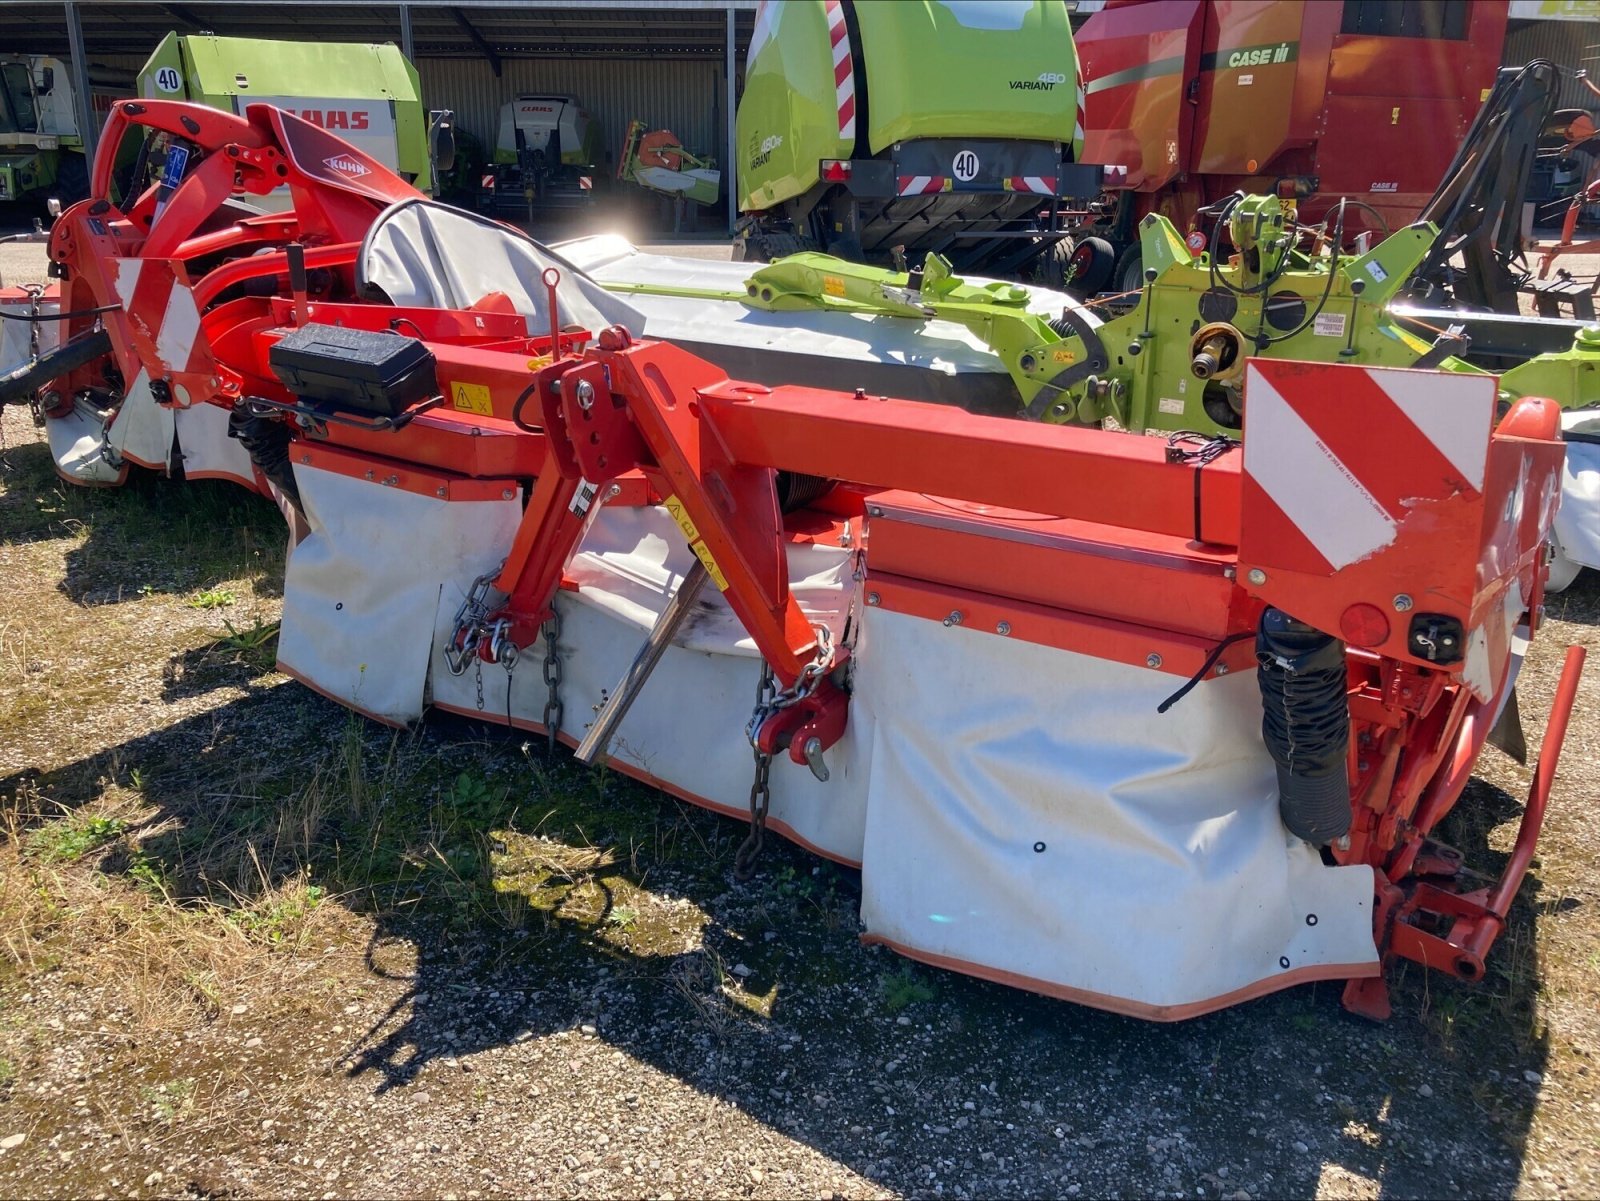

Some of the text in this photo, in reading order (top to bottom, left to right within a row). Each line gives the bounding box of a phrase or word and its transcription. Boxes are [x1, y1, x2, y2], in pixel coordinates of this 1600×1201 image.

[1228, 49, 1272, 68] CASE
[159, 69, 178, 89] 40
[1009, 81, 1055, 91] VARIANT
[1038, 73, 1066, 84] 480
[330, 158, 365, 175] KUHN
[750, 150, 771, 171] VARIANT
[956, 153, 974, 177] 40
